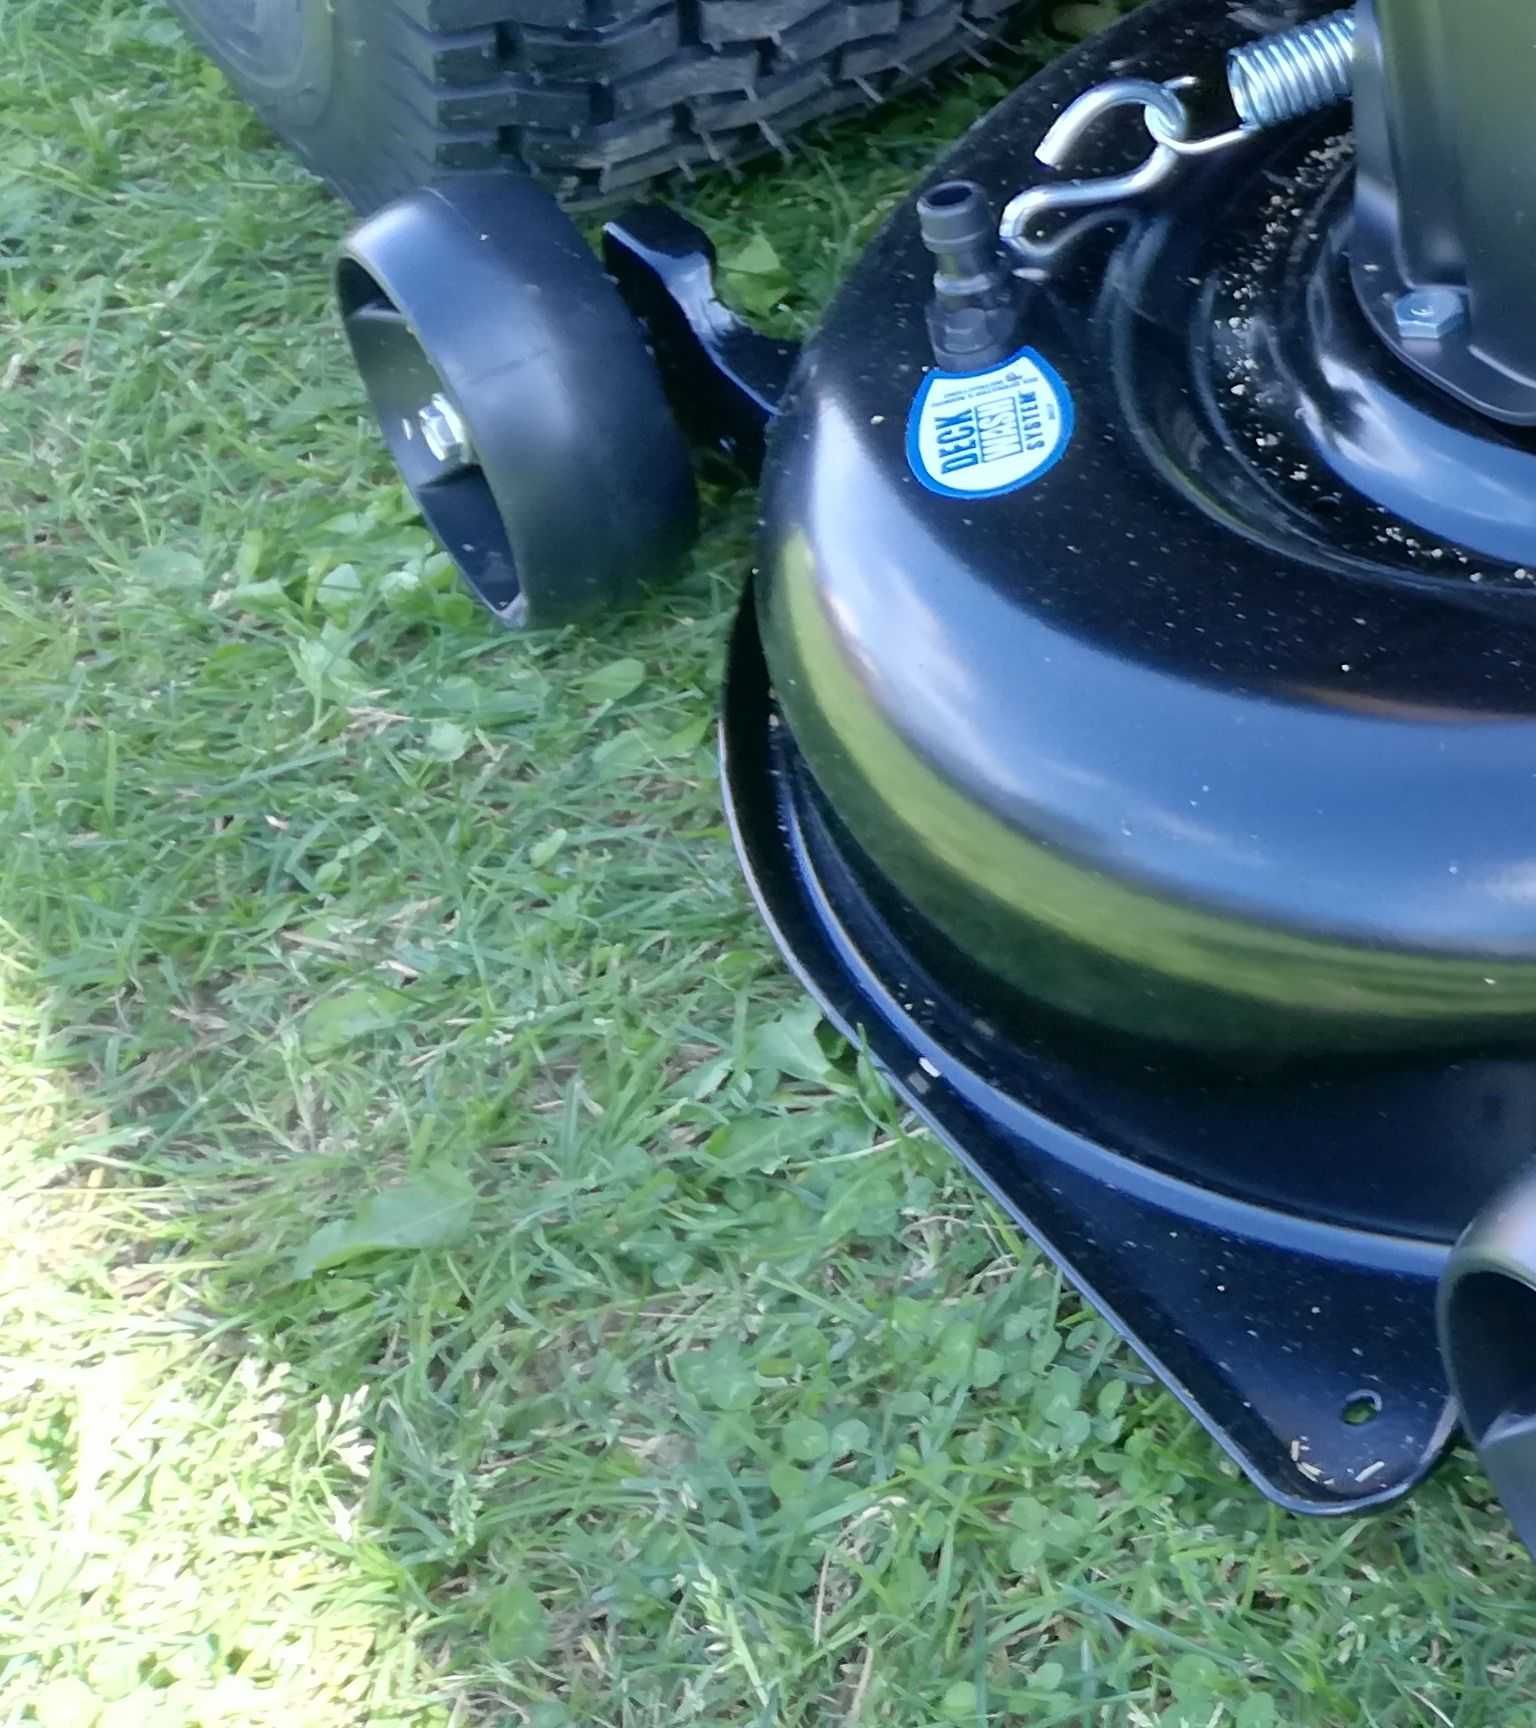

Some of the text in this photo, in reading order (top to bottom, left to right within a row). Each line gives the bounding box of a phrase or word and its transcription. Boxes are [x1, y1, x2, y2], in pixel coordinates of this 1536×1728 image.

[934, 409, 978, 474] DECK
[975, 398, 1020, 462] WASH
[1019, 391, 1045, 451] SYSTEM
